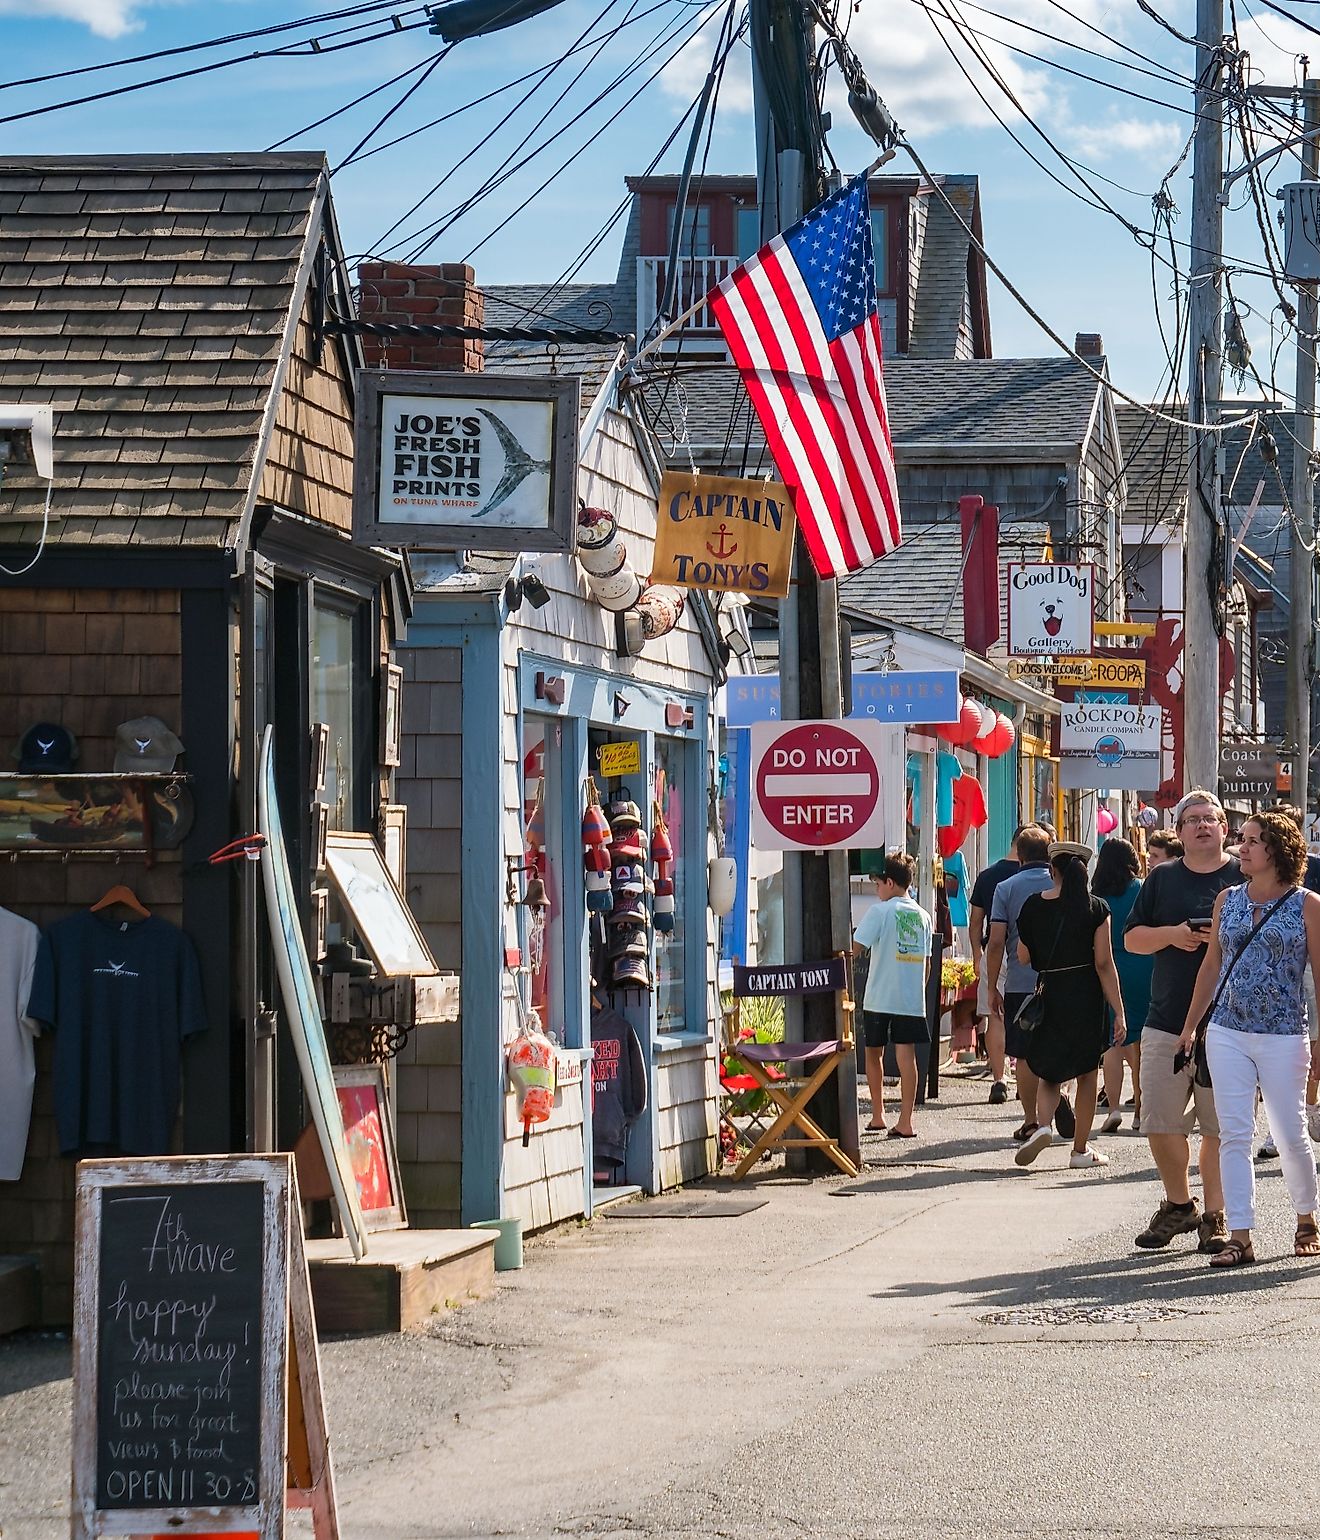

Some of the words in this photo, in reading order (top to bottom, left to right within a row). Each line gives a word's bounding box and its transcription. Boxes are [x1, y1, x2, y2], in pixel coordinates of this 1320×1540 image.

[394, 414, 481, 436] JOE'S
[394, 435, 480, 454] FRESH
[394, 454, 480, 478] FISH
[393, 480, 481, 497] PRINTS
[393, 497, 408, 505] ON
[411, 498, 439, 506] TUNA
[441, 499, 480, 507] WHARF
[670, 490, 785, 532] CAPTAIN
[673, 554, 769, 591] TONY'S
[1013, 566, 1054, 590] Good
[1057, 566, 1087, 597] Dog
[1028, 637, 1071, 648] Gallery
[1016, 663, 1042, 675] DOGS
[1044, 664, 1087, 676] WELCOME!
[1063, 709, 1159, 730] ROCKPORT
[1074, 725, 1105, 733] CANDLE
[1106, 726, 1144, 734] COMPANY
[773, 749, 806, 768] DO
[816, 748, 861, 767] NOT
[1221, 747, 1261, 761] Coast
[1235, 765, 1247, 777] &
[1282, 763, 1289, 775] 4
[1224, 782, 1272, 796] ountry
[782, 804, 854, 825] ENTER
[748, 972, 796, 991] CAPTAIN
[800, 969, 830, 988] TONY
[592, 1039, 620, 1060] KED
[591, 1060, 619, 1080] ART
[167, 1243, 237, 1274] wave
[108, 1279, 216, 1340] happy
[113, 1370, 185, 1416] please
[194, 1378, 229, 1413] join
[119, 1411, 143, 1428] us
[150, 1403, 177, 1429] for
[188, 1411, 240, 1441] great
[108, 1440, 159, 1459] views
[187, 1436, 232, 1462] food
[106, 1467, 173, 1500] OPEN
